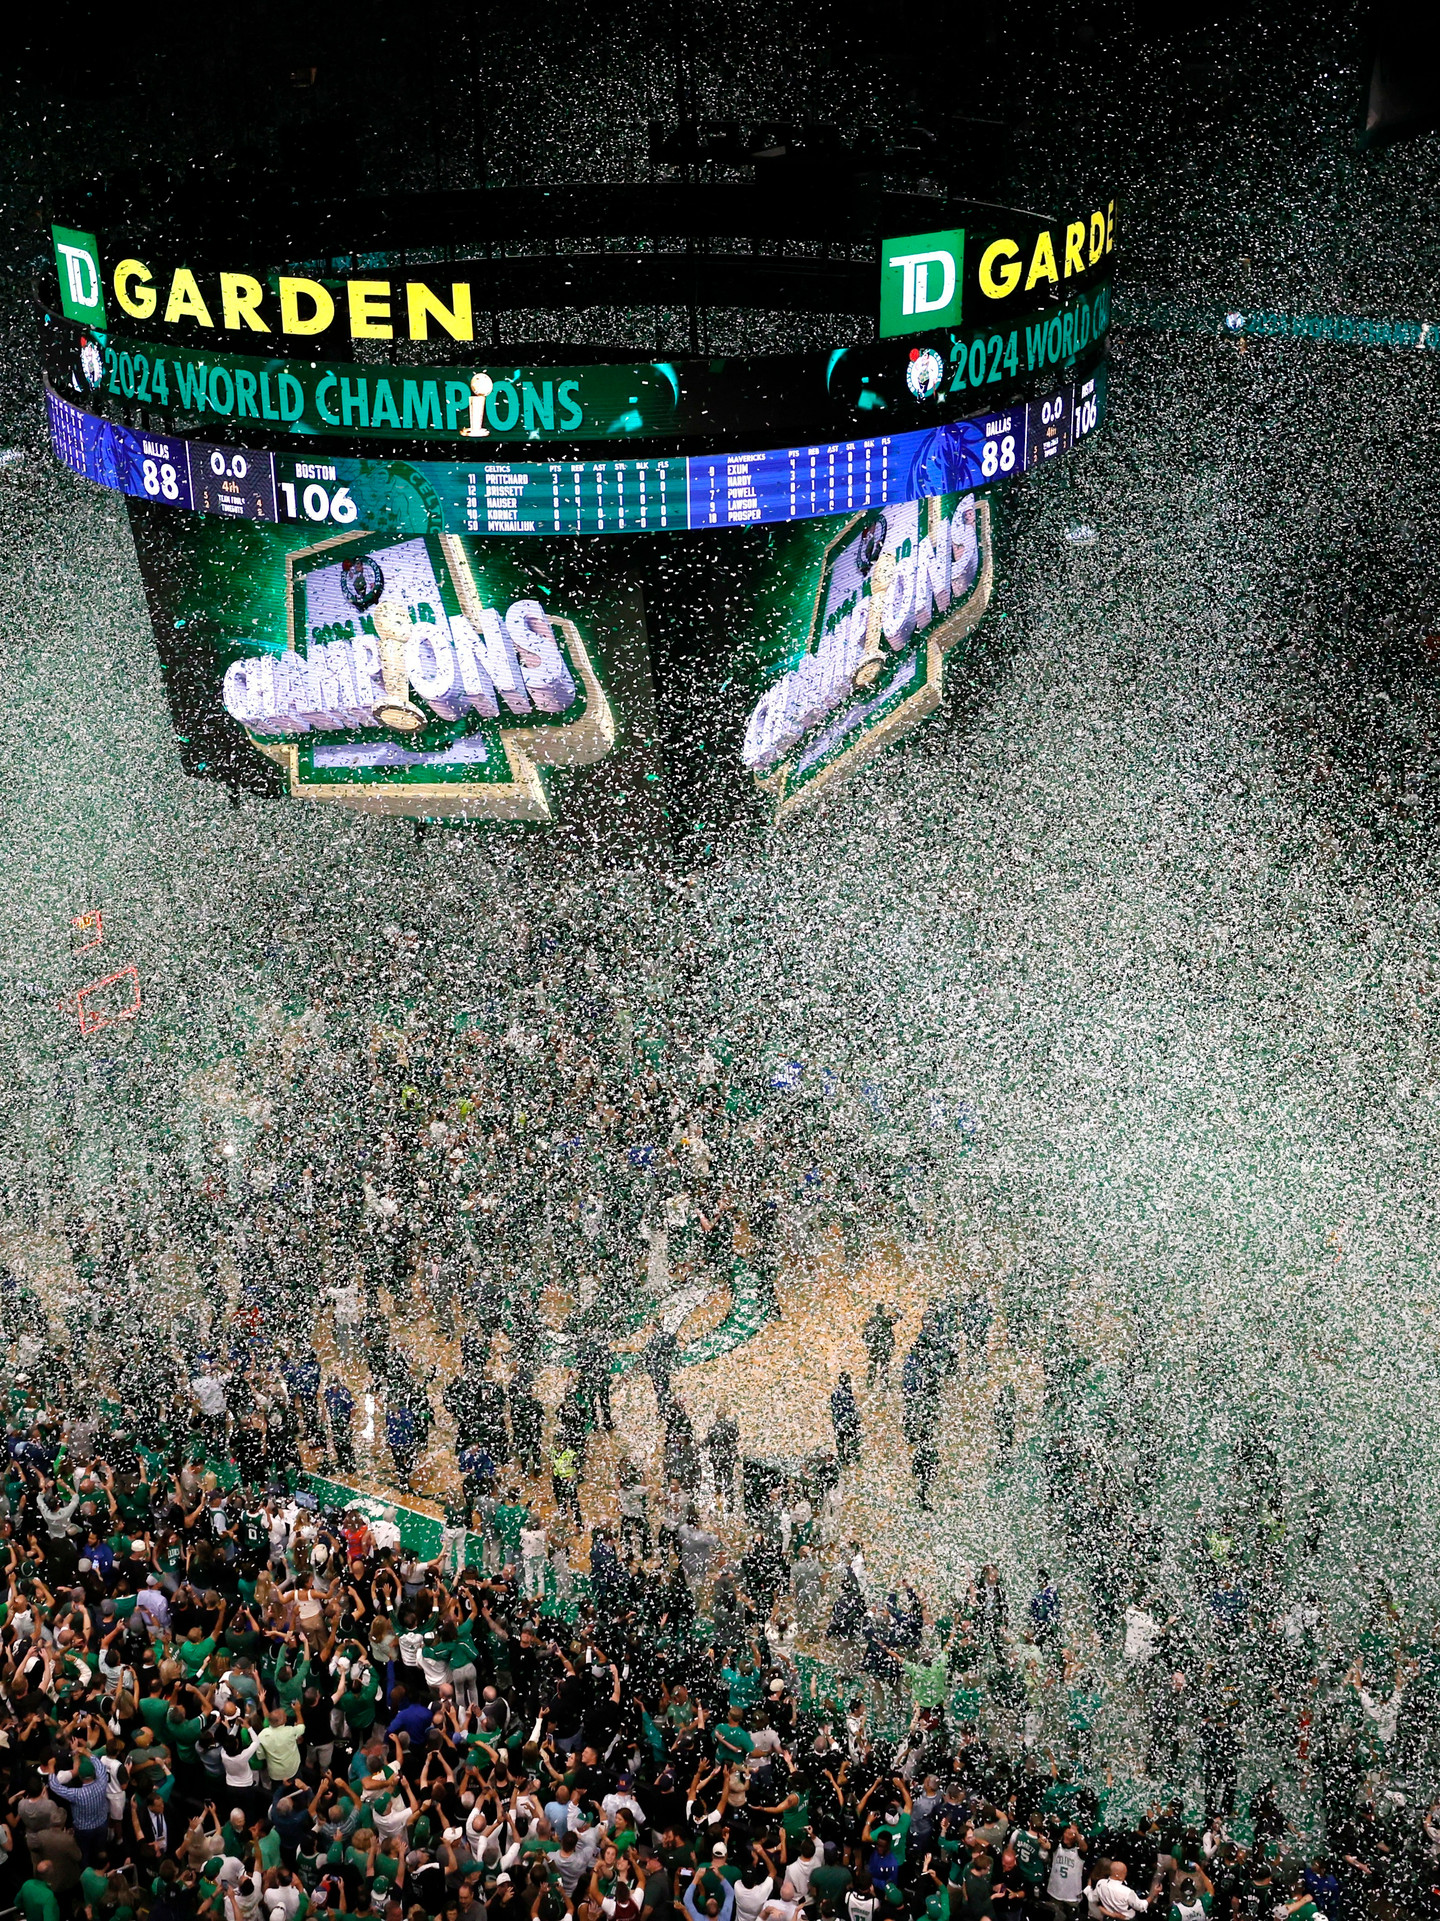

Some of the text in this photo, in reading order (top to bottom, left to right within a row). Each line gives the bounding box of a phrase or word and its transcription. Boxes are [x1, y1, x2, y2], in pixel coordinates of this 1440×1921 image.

[888, 199, 1115, 316] TD GARDE
[57, 243, 473, 341] TD GARDEN
[950, 330, 1019, 392] 2024
[1026, 304, 1090, 371] WORLD
[105, 347, 169, 406] 2024
[173, 361, 304, 421] WORLD
[1041, 396, 1062, 424] 0.0
[1075, 394, 1097, 438] 106
[986, 417, 1011, 437] DALLAS
[142, 439, 169, 459] DALLAS
[727, 453, 766, 464] MAVERICKS
[788, 450, 800, 458] PTS
[981, 435, 1015, 477] 88
[210, 451, 247, 478] 0.0
[295, 463, 336, 481] BOSTON
[484, 465, 511, 473] CELTICS
[549, 465, 562, 473] PTS
[571, 464, 584, 472] REB
[592, 463, 606, 472] AST
[636, 462, 649, 470] BLK
[657, 461, 669, 469] FLS
[727, 464, 748, 475] EXUM
[790, 459, 796, 470] 4
[142, 459, 180, 500] 88
[468, 473, 476, 484] 11
[485, 474, 529, 485] PRITCHARD
[552, 473, 558, 484] 3
[574, 473, 580, 484] 0
[617, 471, 623, 482] 0
[639, 470, 645, 481] 0
[660, 469, 666, 480] 0
[727, 475, 751, 487] HARDY
[790, 470, 796, 481] 3
[203, 491, 208, 499] 5
[468, 481, 666, 497] 12 BRISSETT 0 0 0 0 0 0
[709, 489, 715, 501] 7
[727, 486, 757, 499] POWELL
[204, 500, 209, 509] 2
[256, 499, 262, 507] 4
[282, 482, 357, 524] 106
[409, 472, 442, 534] CELTIC
[466, 497, 477, 508] 30
[486, 498, 517, 509] HAUSER
[575, 496, 581, 507] 4
[598, 495, 602, 506] 1
[619, 495, 623, 506] 1
[640, 494, 646, 505] 0
[661, 493, 665, 504] 1
[709, 501, 716, 512] 9
[728, 498, 758, 511] LAWSON
[467, 504, 667, 520] 40 KORNET 0 1 0 0 0 0
[728, 508, 762, 522] PROSPER
[468, 516, 667, 532] 50 MYKHAILIUK 0 1 0 0 0 0
[248, 1528, 257, 1540] 0
[892, 1833, 901, 1846] 7
[1020, 1848, 1031, 1863] 5
[1060, 1866, 1068, 1878] 5
